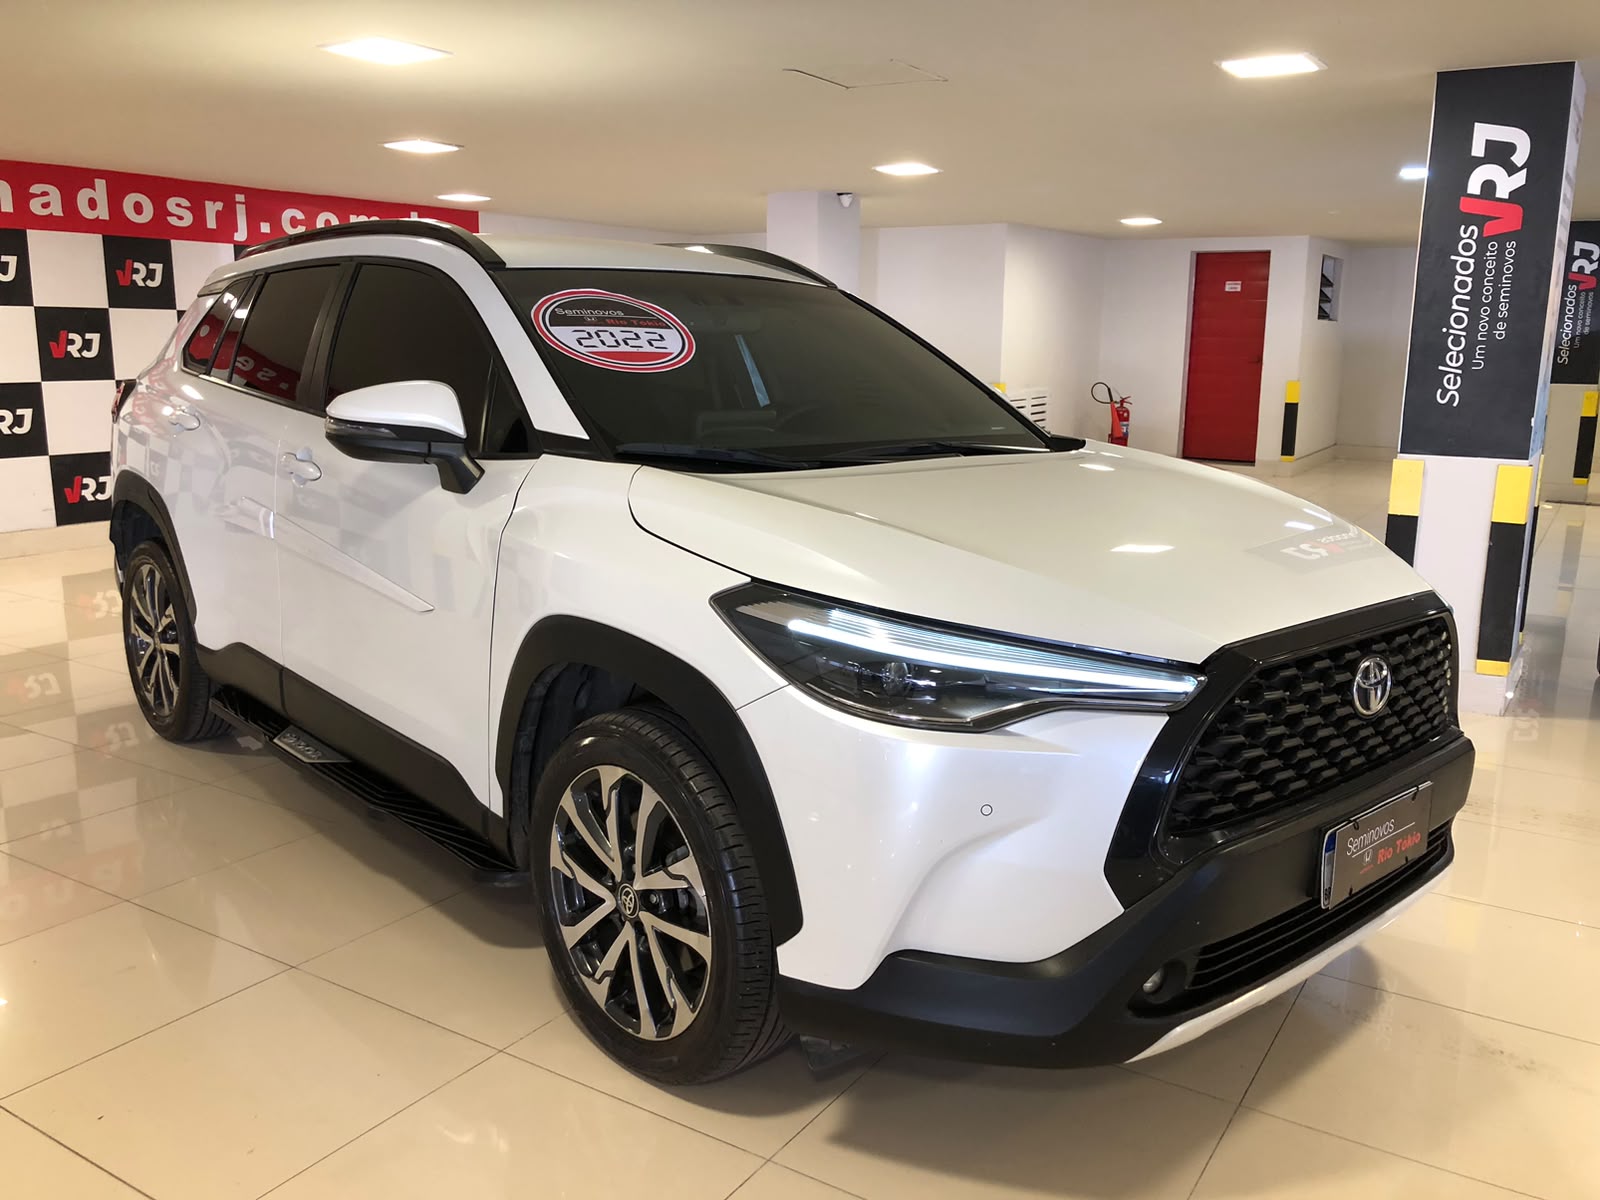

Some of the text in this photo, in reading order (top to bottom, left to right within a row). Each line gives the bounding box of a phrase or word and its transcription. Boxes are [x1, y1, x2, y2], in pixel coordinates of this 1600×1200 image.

[554, 308, 625, 316] Seminovos
[1471, 241, 1499, 370] Um novo conceito
[1492, 240, 1517, 340] de seminovos
[1585, 291, 1594, 325] seminovos
[571, 329, 669, 350] 2022
[1436, 224, 1479, 408] Selecionados
[1557, 284, 1578, 365] Selecionados
[1573, 291, 1586, 349] Um novo conceito
[1346, 818, 1396, 856] Seminovos
[1377, 831, 1422, 865] Rio Tokio
